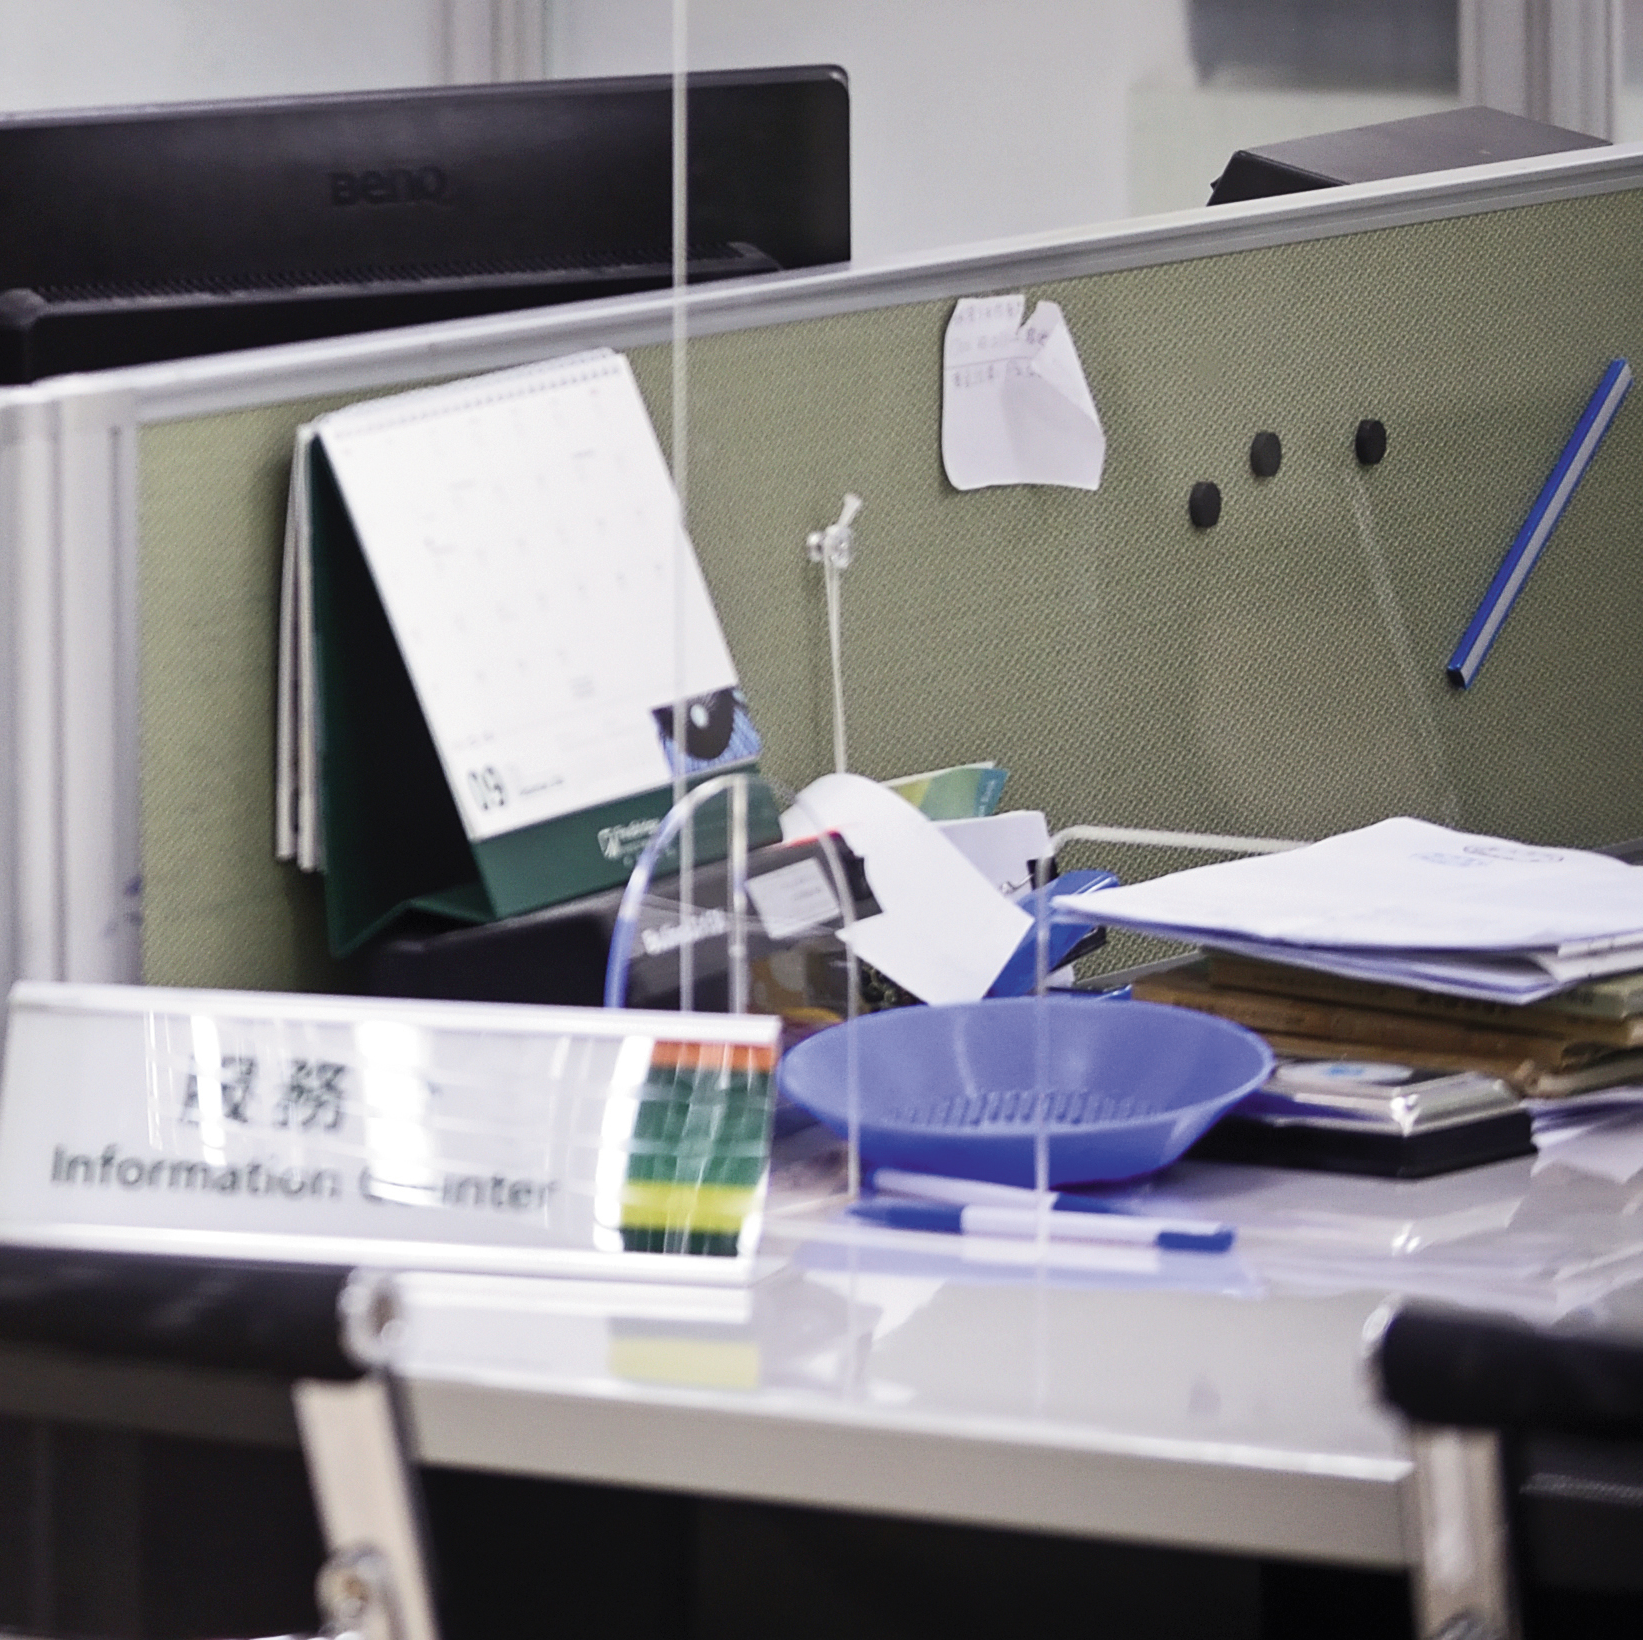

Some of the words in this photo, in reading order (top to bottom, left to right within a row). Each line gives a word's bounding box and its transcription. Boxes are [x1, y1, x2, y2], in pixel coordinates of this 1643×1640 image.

[329, 166, 451, 206] BenQ
[50, 1143, 341, 1201] Information
[357, 1164, 561, 1211] Cnter
